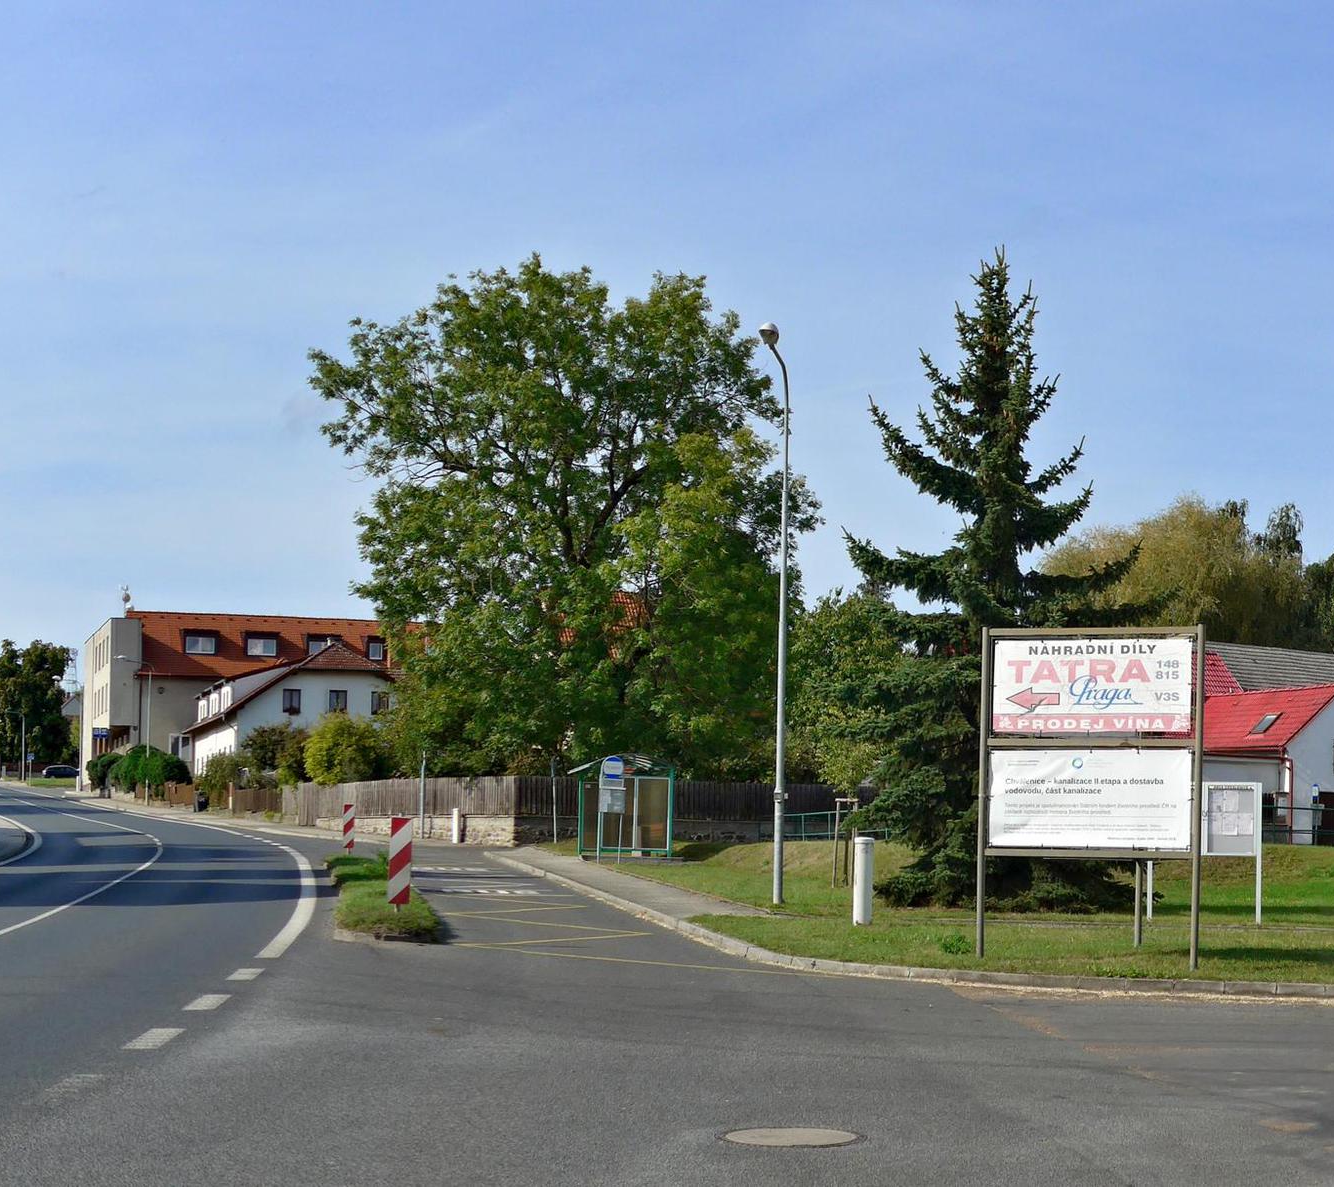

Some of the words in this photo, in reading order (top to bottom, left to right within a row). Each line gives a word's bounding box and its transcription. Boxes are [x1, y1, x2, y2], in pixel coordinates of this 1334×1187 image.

[1028, 643, 1114, 656] NÁHRADNÍ
[1120, 641, 1157, 655] DÍLY
[1156, 659, 1180, 669] 148
[1007, 658, 1151, 684] TATRA
[1155, 670, 1179, 680] 815
[1069, 675, 1143, 710] Praga
[1154, 692, 1180, 702] V3S
[1017, 718, 1104, 730] PRODEJ
[1112, 715, 1166, 729] VÍNA
[1053, 777, 1093, 785] kanalizace
[1129, 777, 1164, 785] dostavba
[1063, 787, 1102, 795] kanalizace
